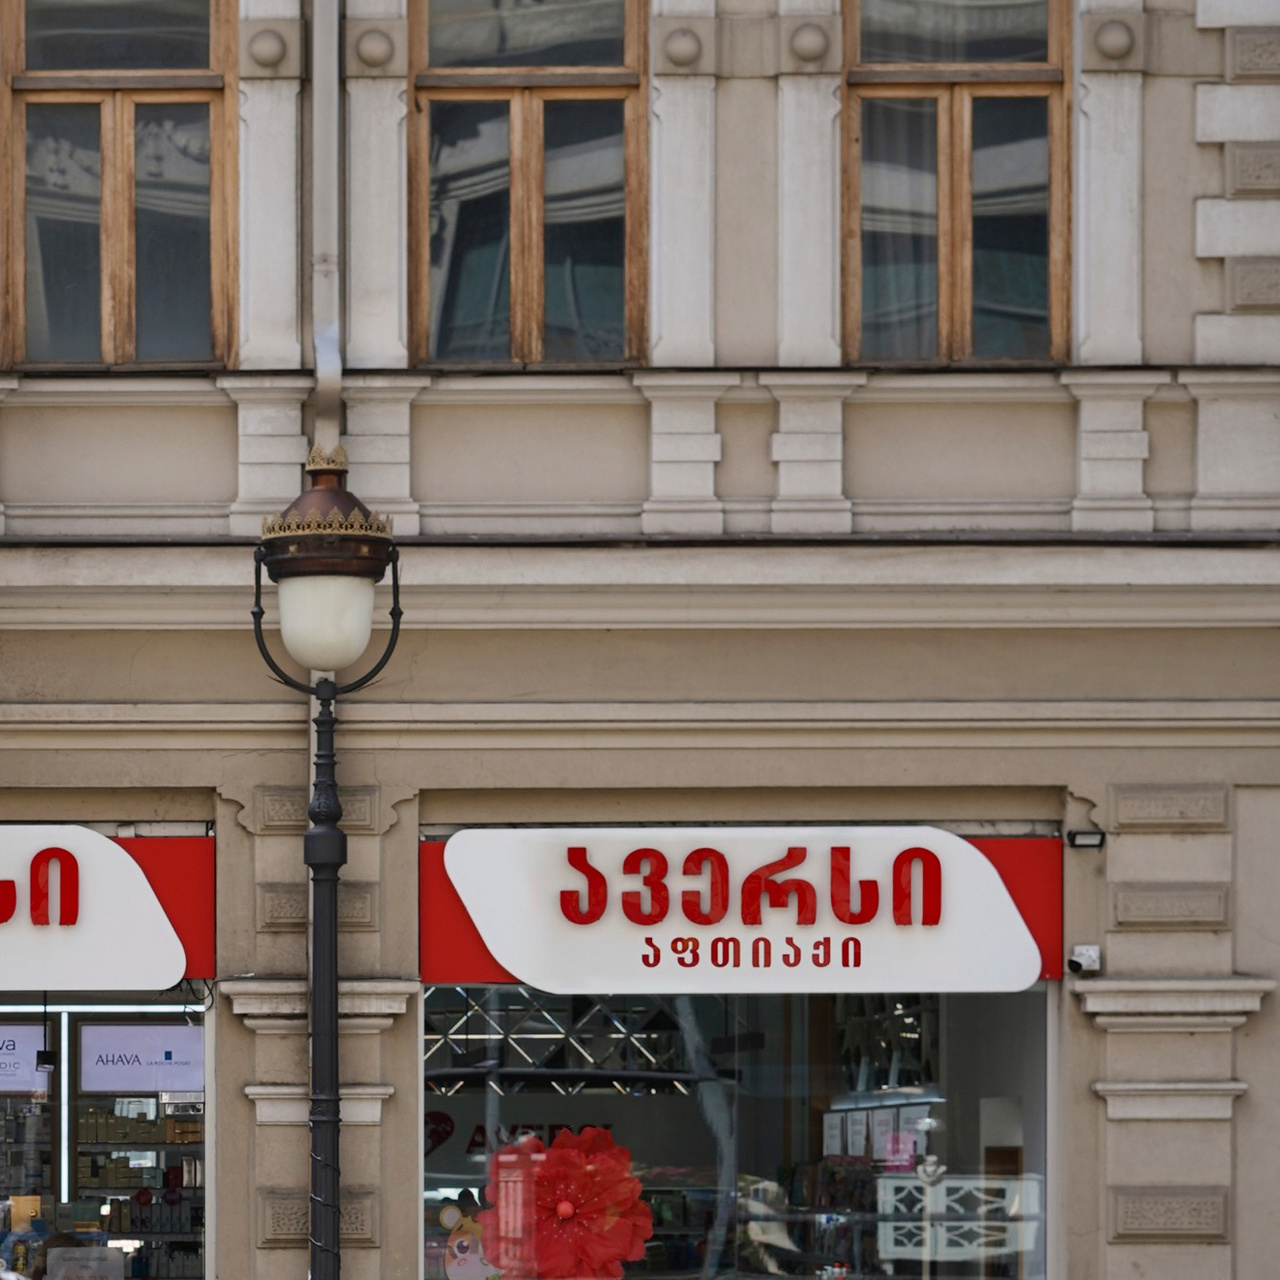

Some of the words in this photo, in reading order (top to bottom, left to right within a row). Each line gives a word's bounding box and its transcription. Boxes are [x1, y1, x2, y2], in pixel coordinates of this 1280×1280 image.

[559, 846, 942, 926] ავერსი
[642, 937, 861, 968] აფთიაქი
[95, 1053, 142, 1066] AHAVA
